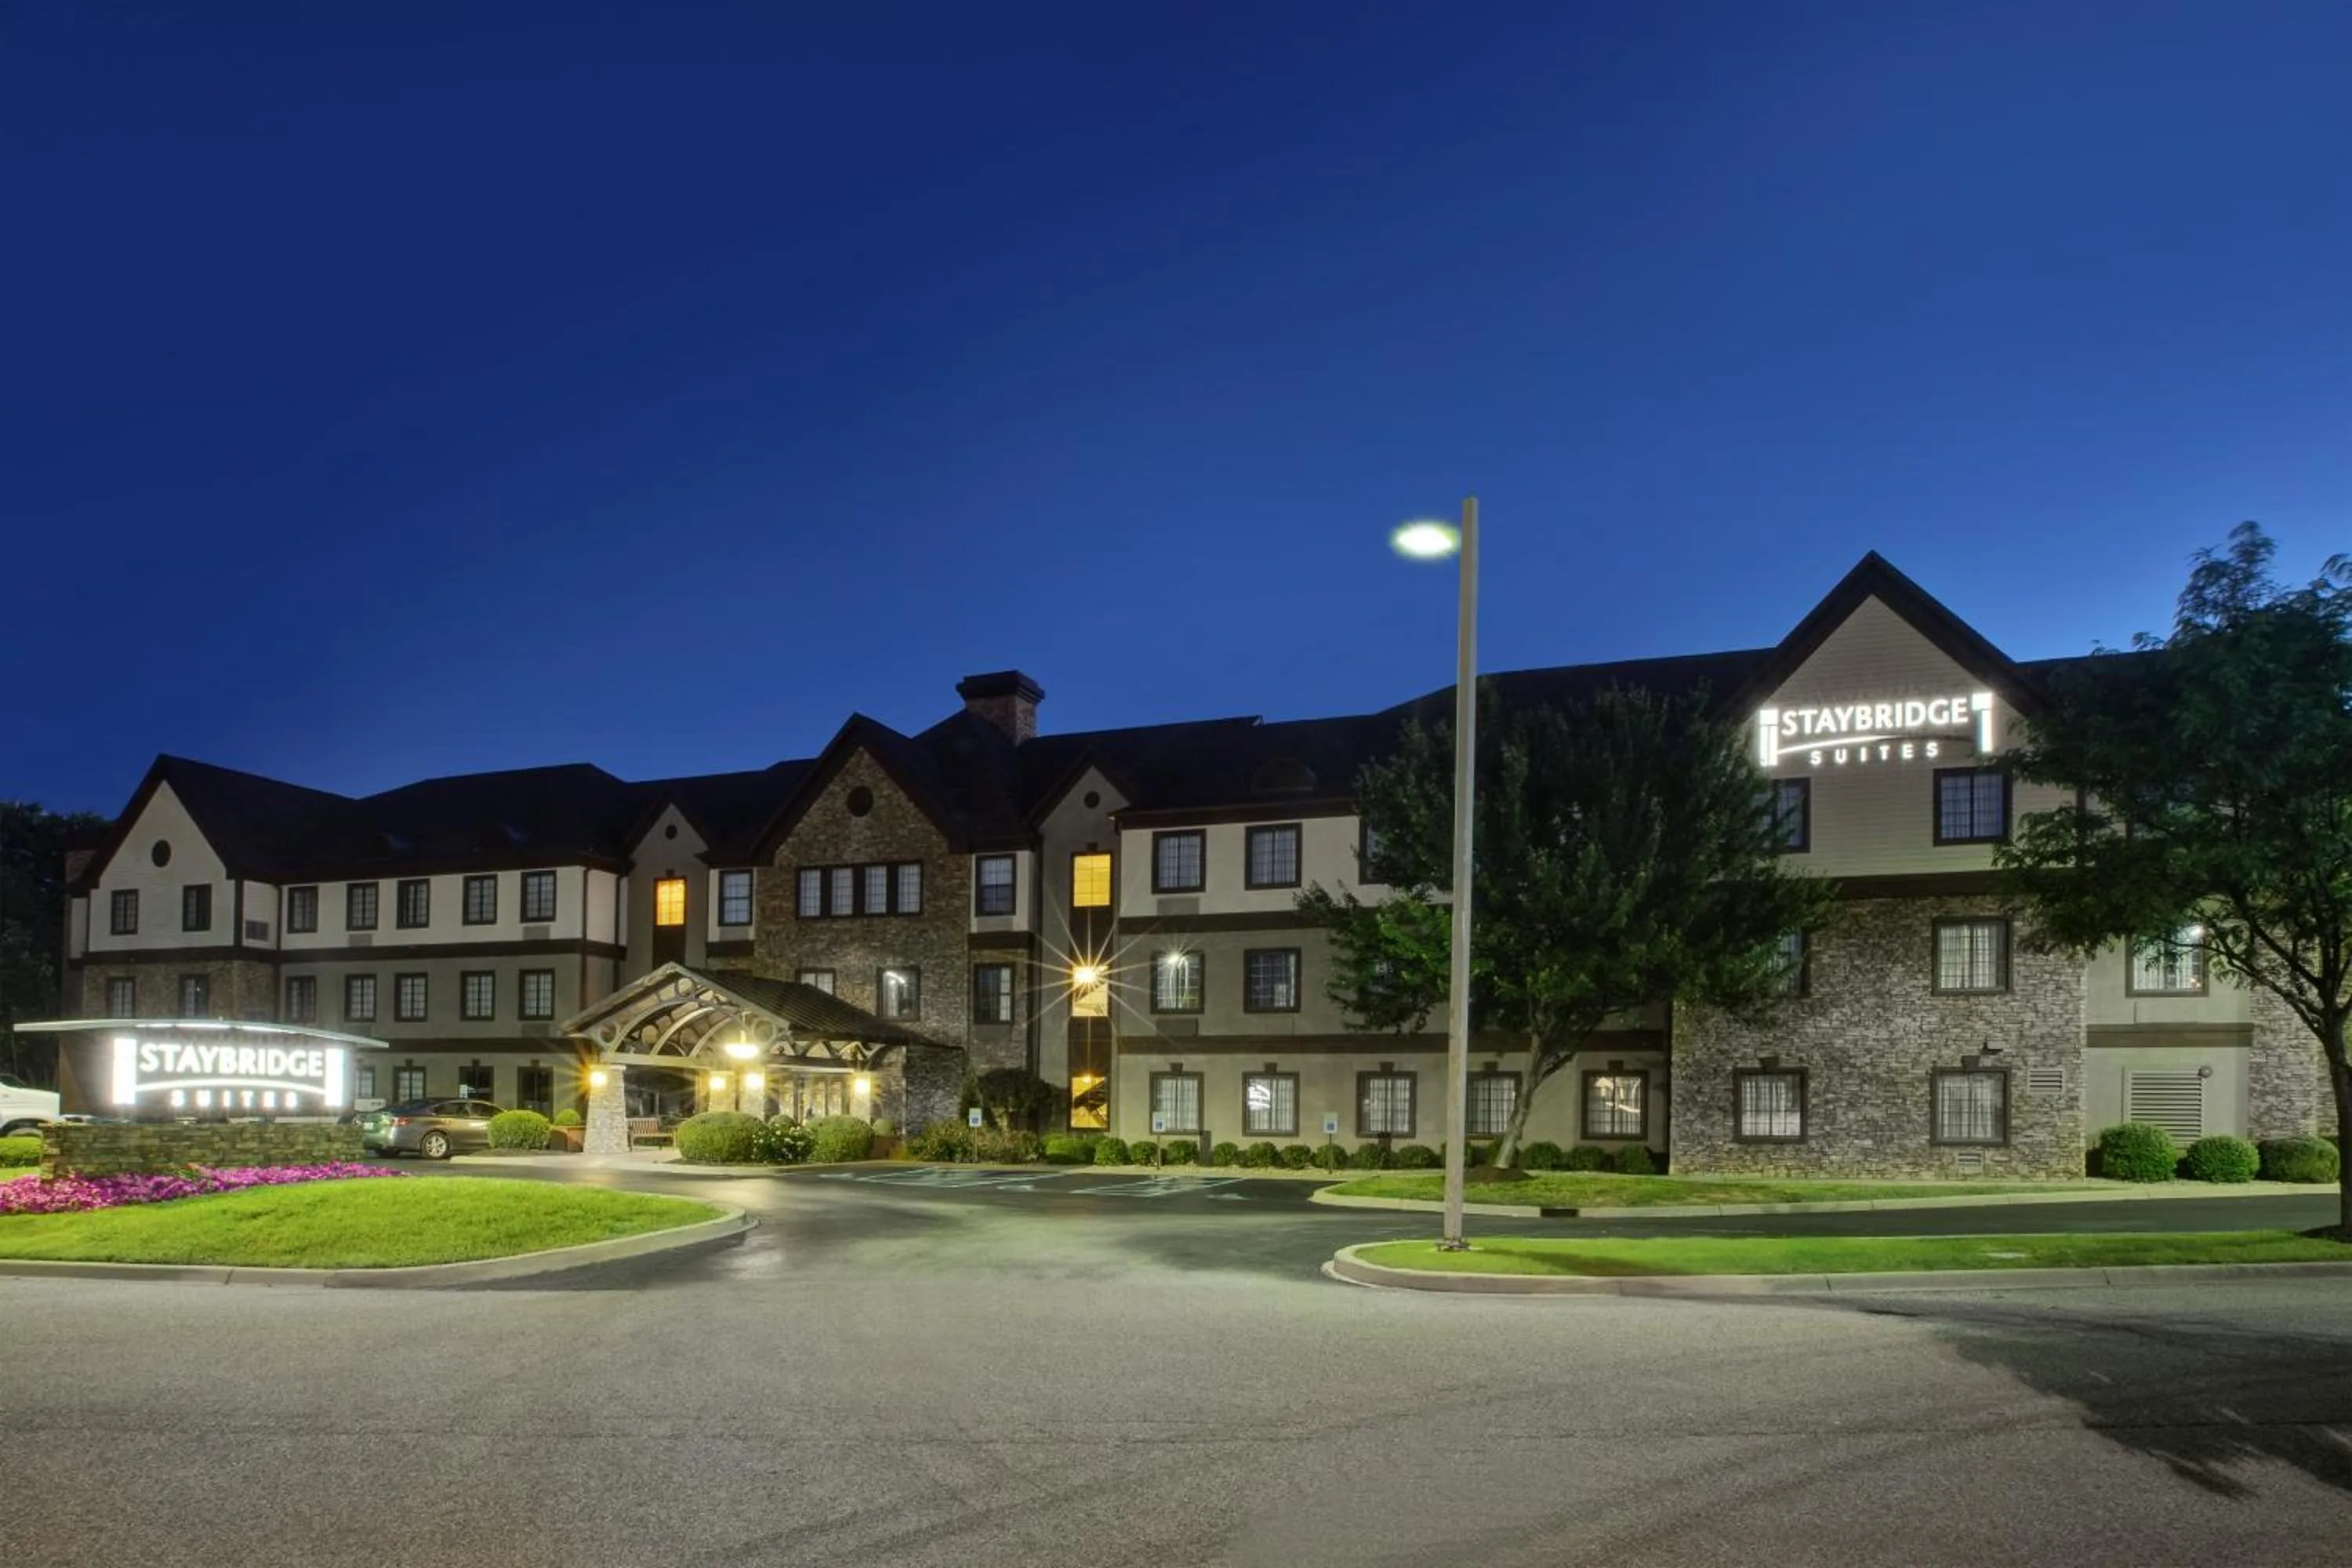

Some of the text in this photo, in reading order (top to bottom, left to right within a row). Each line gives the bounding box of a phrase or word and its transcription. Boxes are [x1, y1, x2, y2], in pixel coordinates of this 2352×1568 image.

[1781, 697, 1969, 735] STAYBRIDGE
[1809, 742, 1940, 765] SUITES
[140, 1043, 324, 1077] STAYBRIDGE
